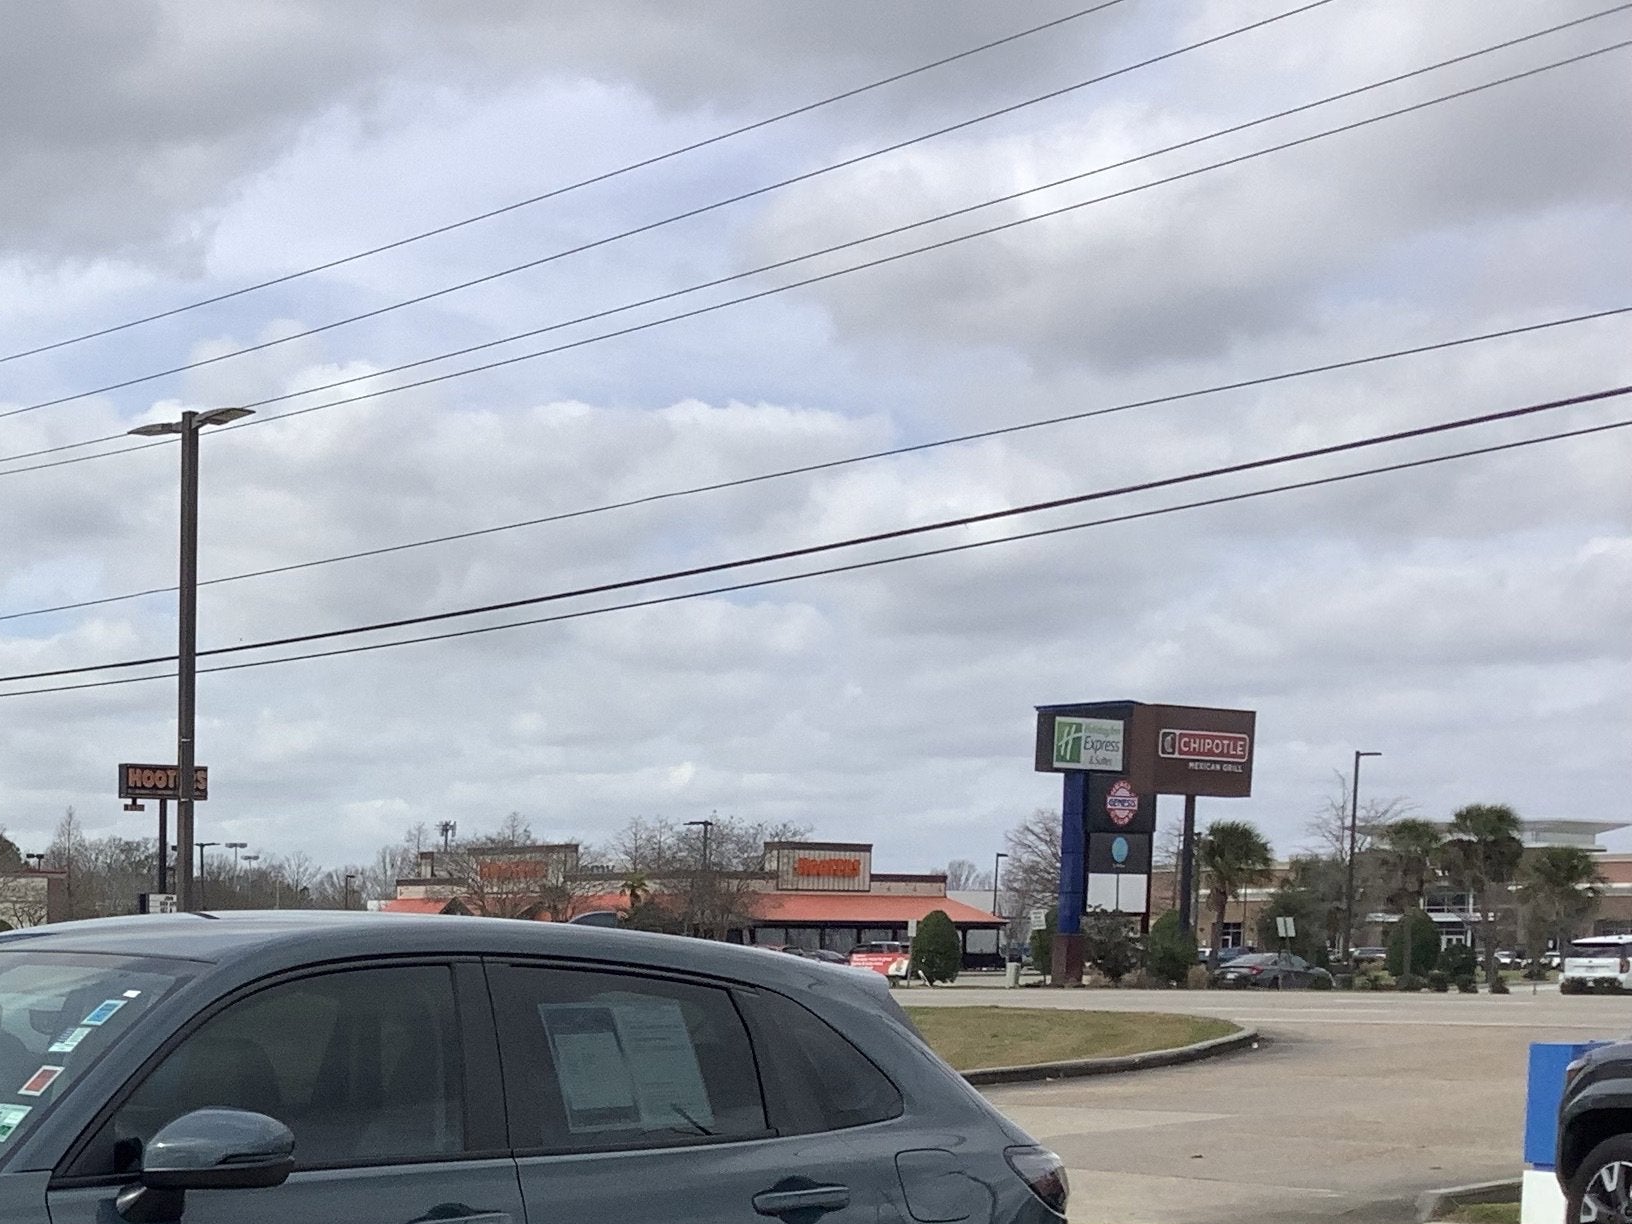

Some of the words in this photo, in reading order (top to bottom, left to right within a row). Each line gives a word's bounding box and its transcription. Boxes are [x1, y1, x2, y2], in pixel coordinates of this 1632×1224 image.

[1084, 736, 1120, 754] Express
[1180, 737, 1245, 755] CHIPOTLE
[1188, 762, 1220, 771] MEXICAN
[1222, 764, 1243, 773] GRILL
[128, 768, 207, 789] HOOTS
